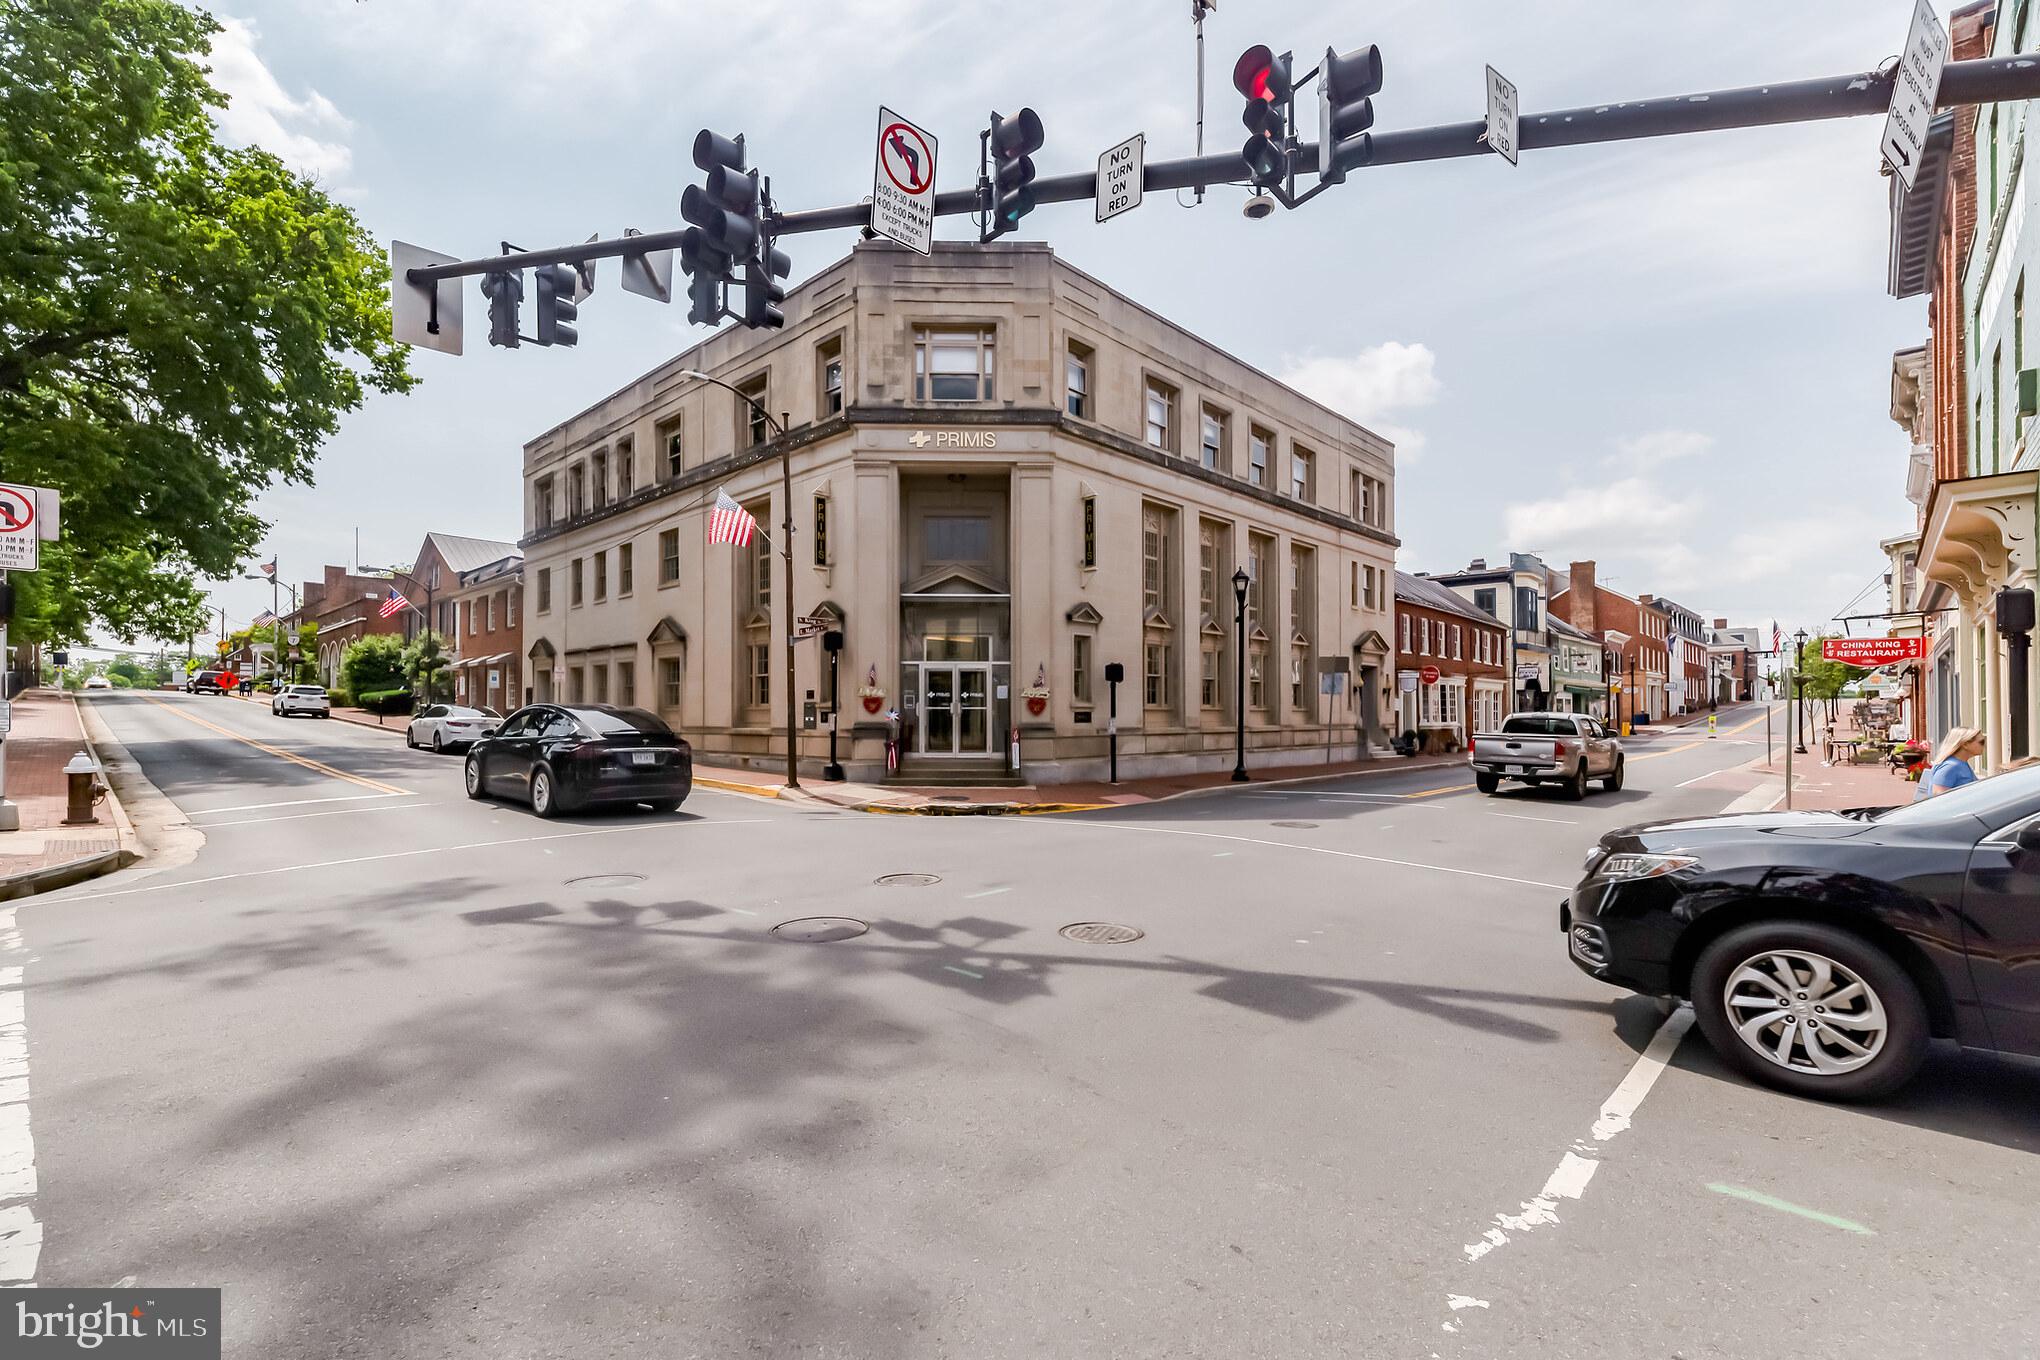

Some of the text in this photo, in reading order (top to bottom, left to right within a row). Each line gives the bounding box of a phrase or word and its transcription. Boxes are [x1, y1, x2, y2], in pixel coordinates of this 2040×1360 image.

[1920, 9, 1942, 51] VEHICLES
[1920, 36, 1933, 62] MUST
[1912, 50, 1932, 89] YIELD TO
[1495, 78, 1509, 100] NO
[1902, 65, 1931, 115] PEDESTRIANS
[1495, 96, 1512, 120] TURN
[1909, 104, 1916, 117] AT
[1499, 117, 1508, 134] ON
[1892, 106, 1922, 150] CROSSWALK
[1497, 132, 1510, 152] RED
[1110, 147, 1130, 166] NO
[1107, 162, 1133, 182] TURN
[1112, 180, 1126, 195] ON
[908, 199, 918, 211] AM
[1109, 195, 1128, 212] RED
[882, 212, 922, 238] EXCEPT TRUCKS
[908, 211, 917, 224] PM
[888, 227, 899, 236] AND
[936, 432, 996, 448] PRIMIS
[1836, 649, 1905, 657] RESTAURANT
